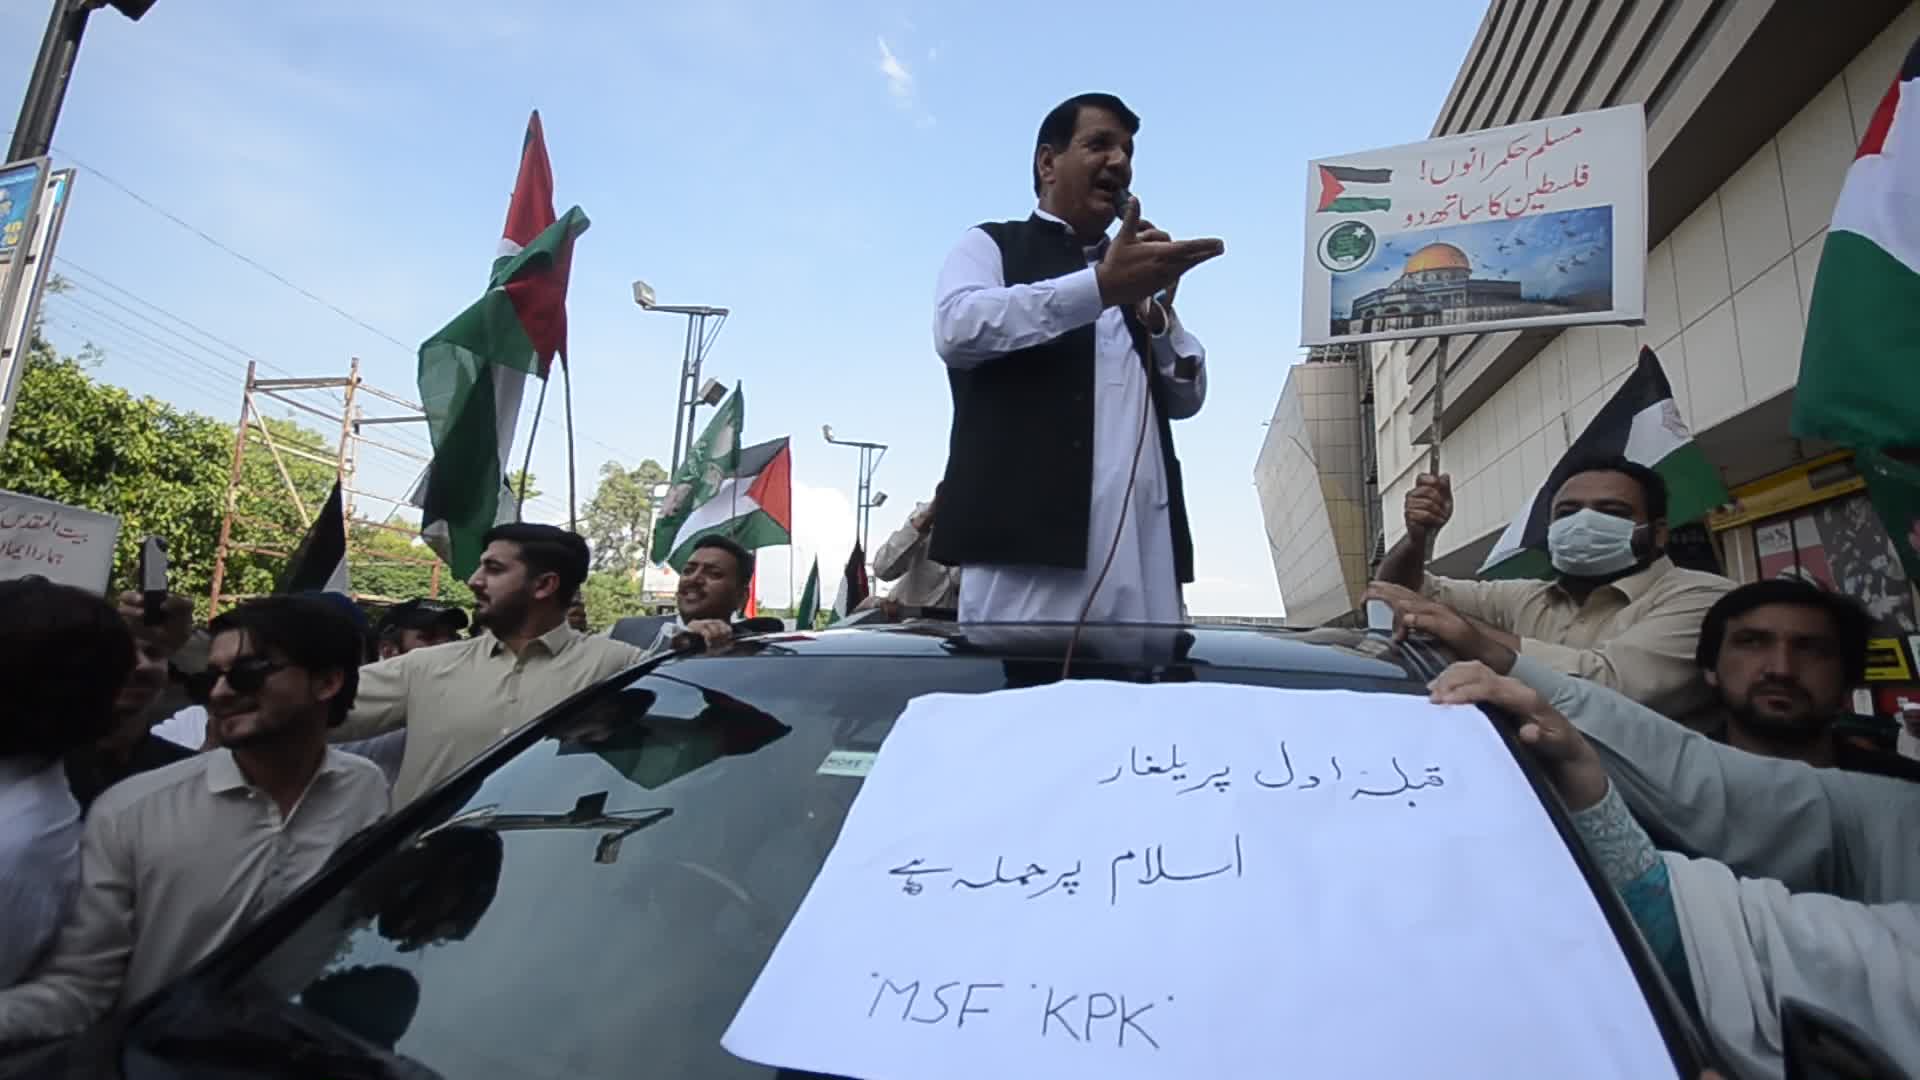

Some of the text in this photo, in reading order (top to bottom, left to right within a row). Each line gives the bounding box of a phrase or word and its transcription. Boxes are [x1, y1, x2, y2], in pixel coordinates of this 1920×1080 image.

[1524, 126, 1583, 180] مسلم
[1401, 162, 1590, 229] فلسطین کا ساتھ دو
[1176, 765, 1231, 795] پر
[952, 855, 1048, 889] حملہ
[1026, 859, 1081, 899] پر
[1111, 832, 1242, 905] اسلام
